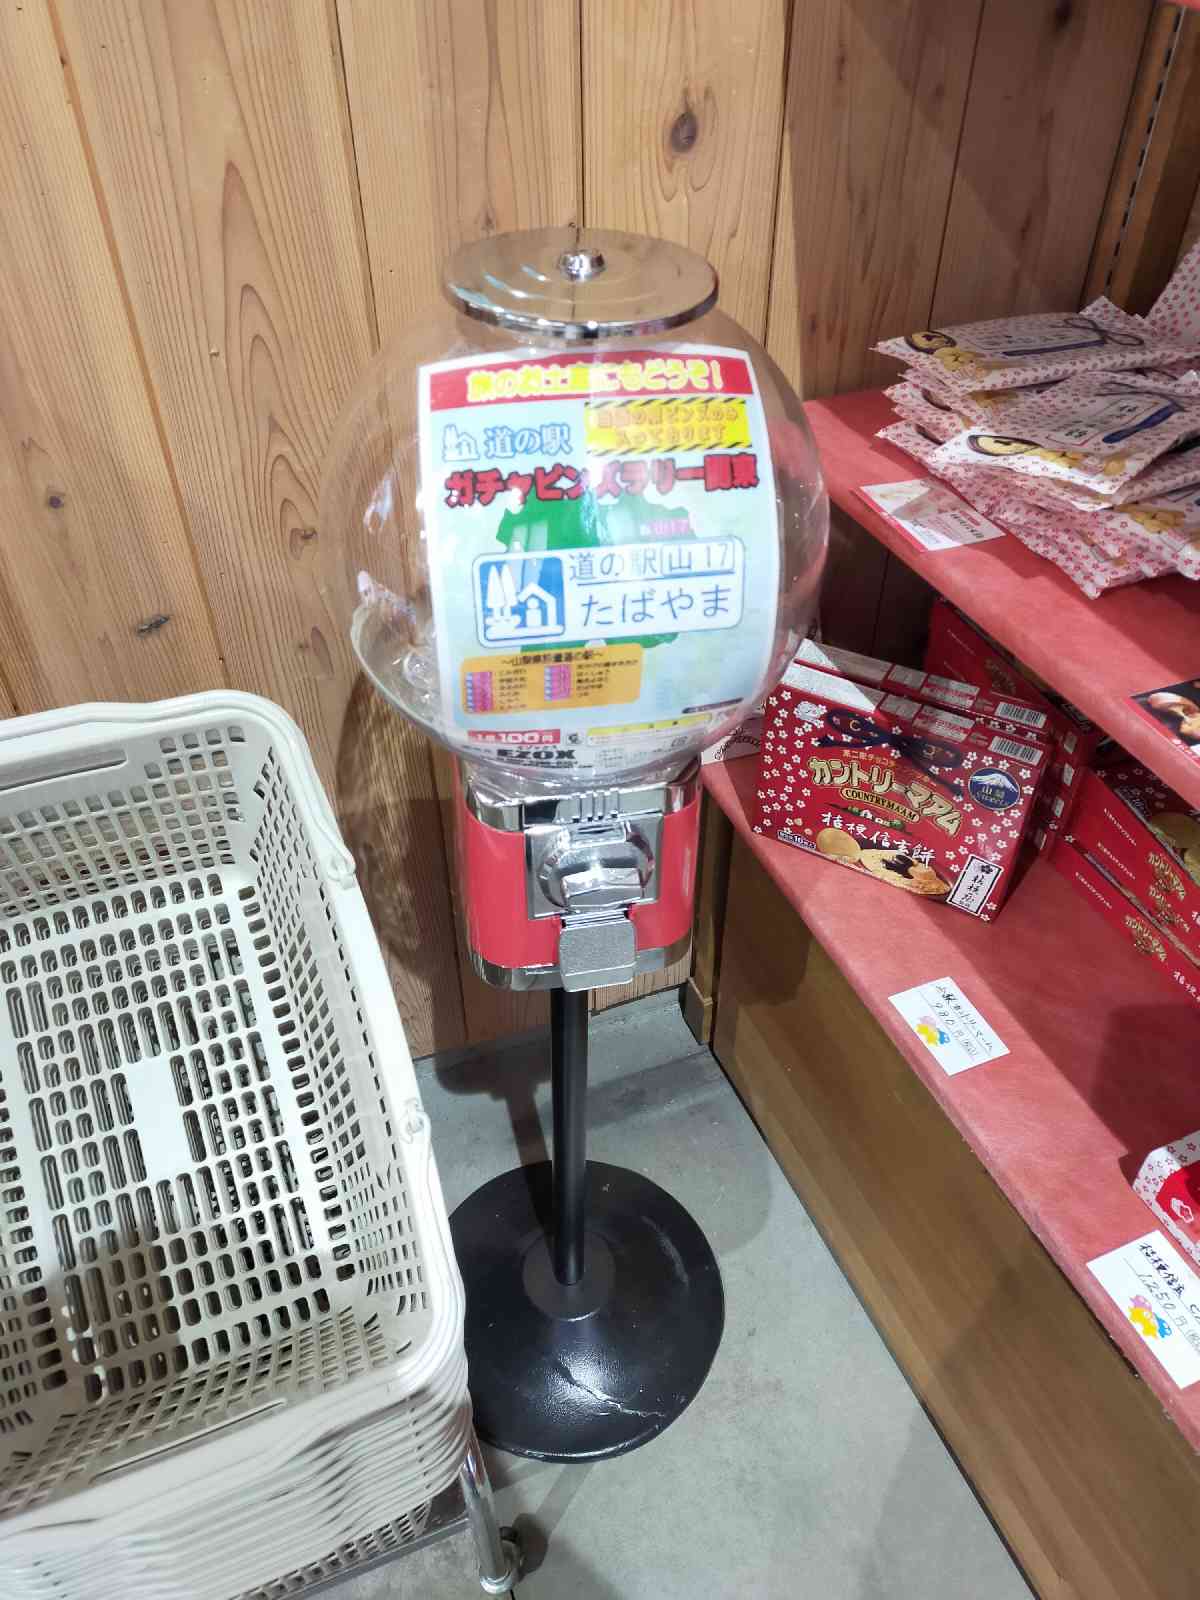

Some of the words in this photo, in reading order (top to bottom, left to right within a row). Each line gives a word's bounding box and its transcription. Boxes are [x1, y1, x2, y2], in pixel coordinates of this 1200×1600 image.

[483, 422, 574, 459] 道の駅
[569, 548, 658, 580] 道の駅
[581, 584, 732, 627] たばやま
[845, 788, 887, 806] COUNTRY
[820, 811, 936, 869] 桔梗信玄餅
